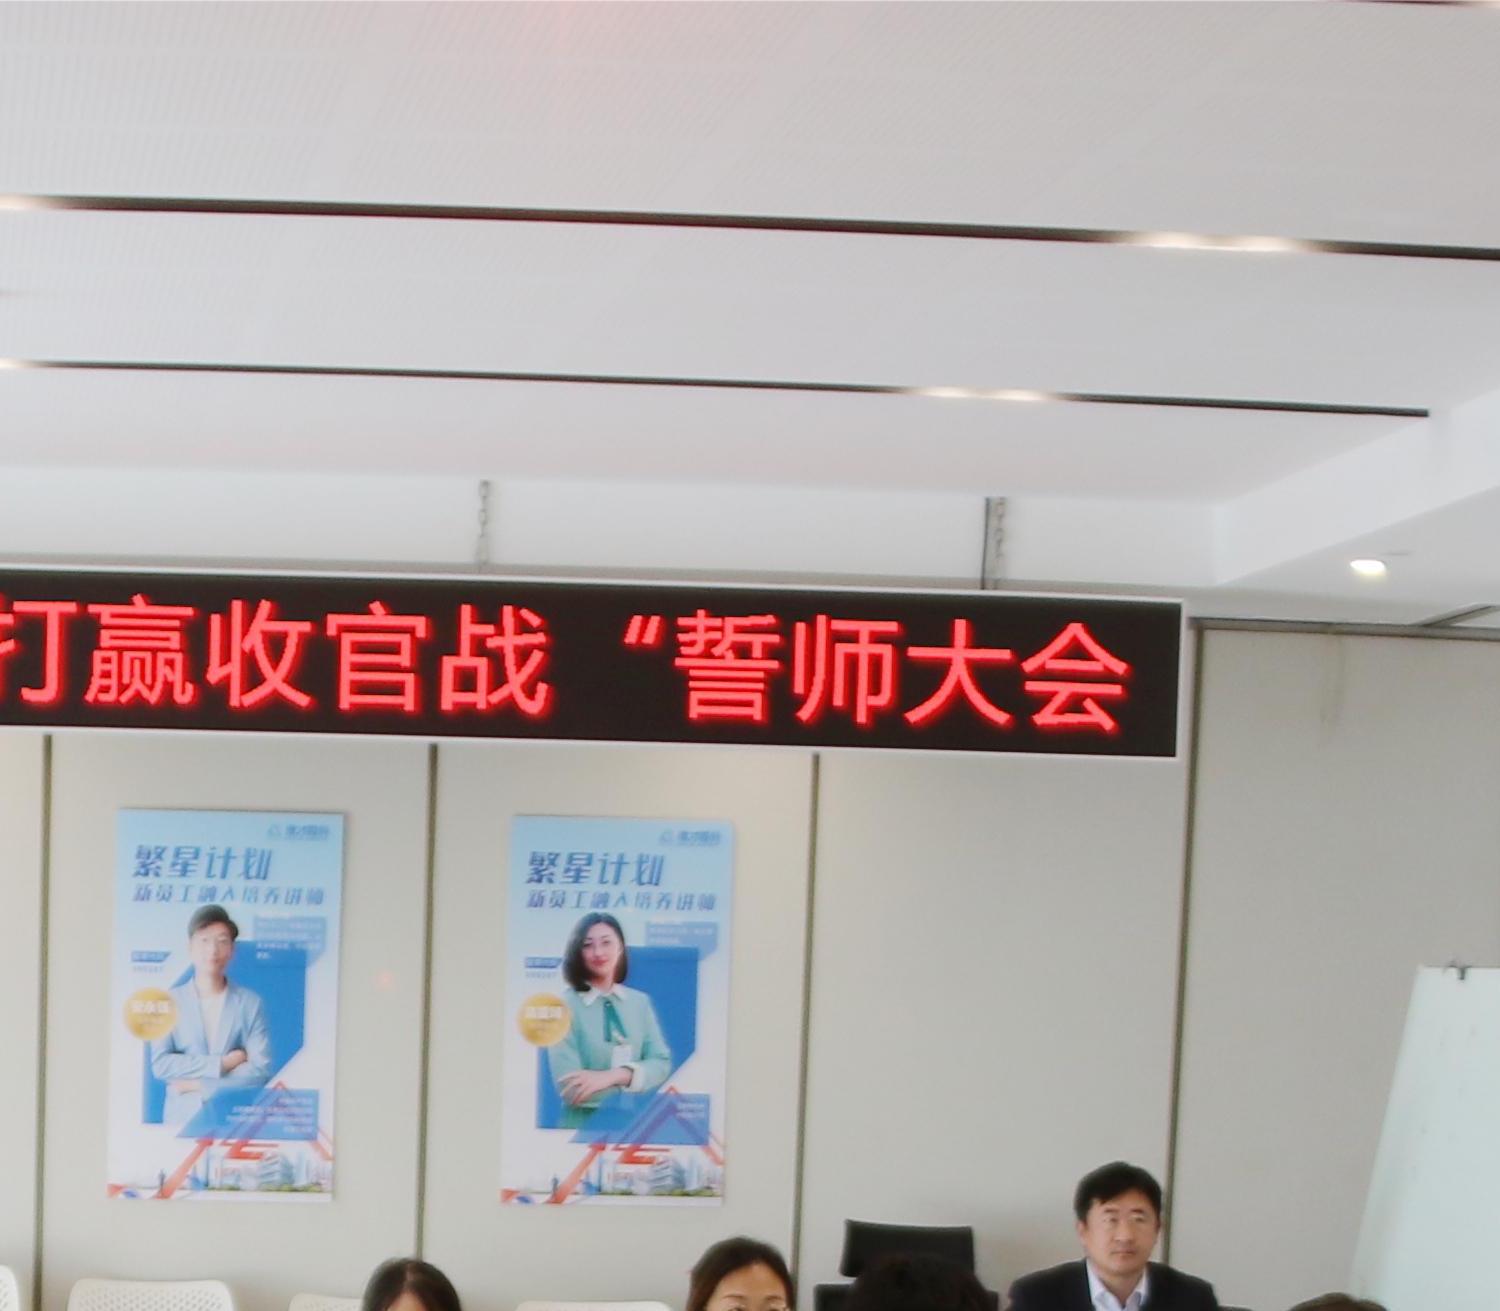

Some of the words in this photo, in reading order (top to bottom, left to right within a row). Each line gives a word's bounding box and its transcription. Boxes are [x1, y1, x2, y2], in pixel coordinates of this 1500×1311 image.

[132, 845, 273, 881] 繁星计划
[525, 851, 666, 887] 繁星计划
